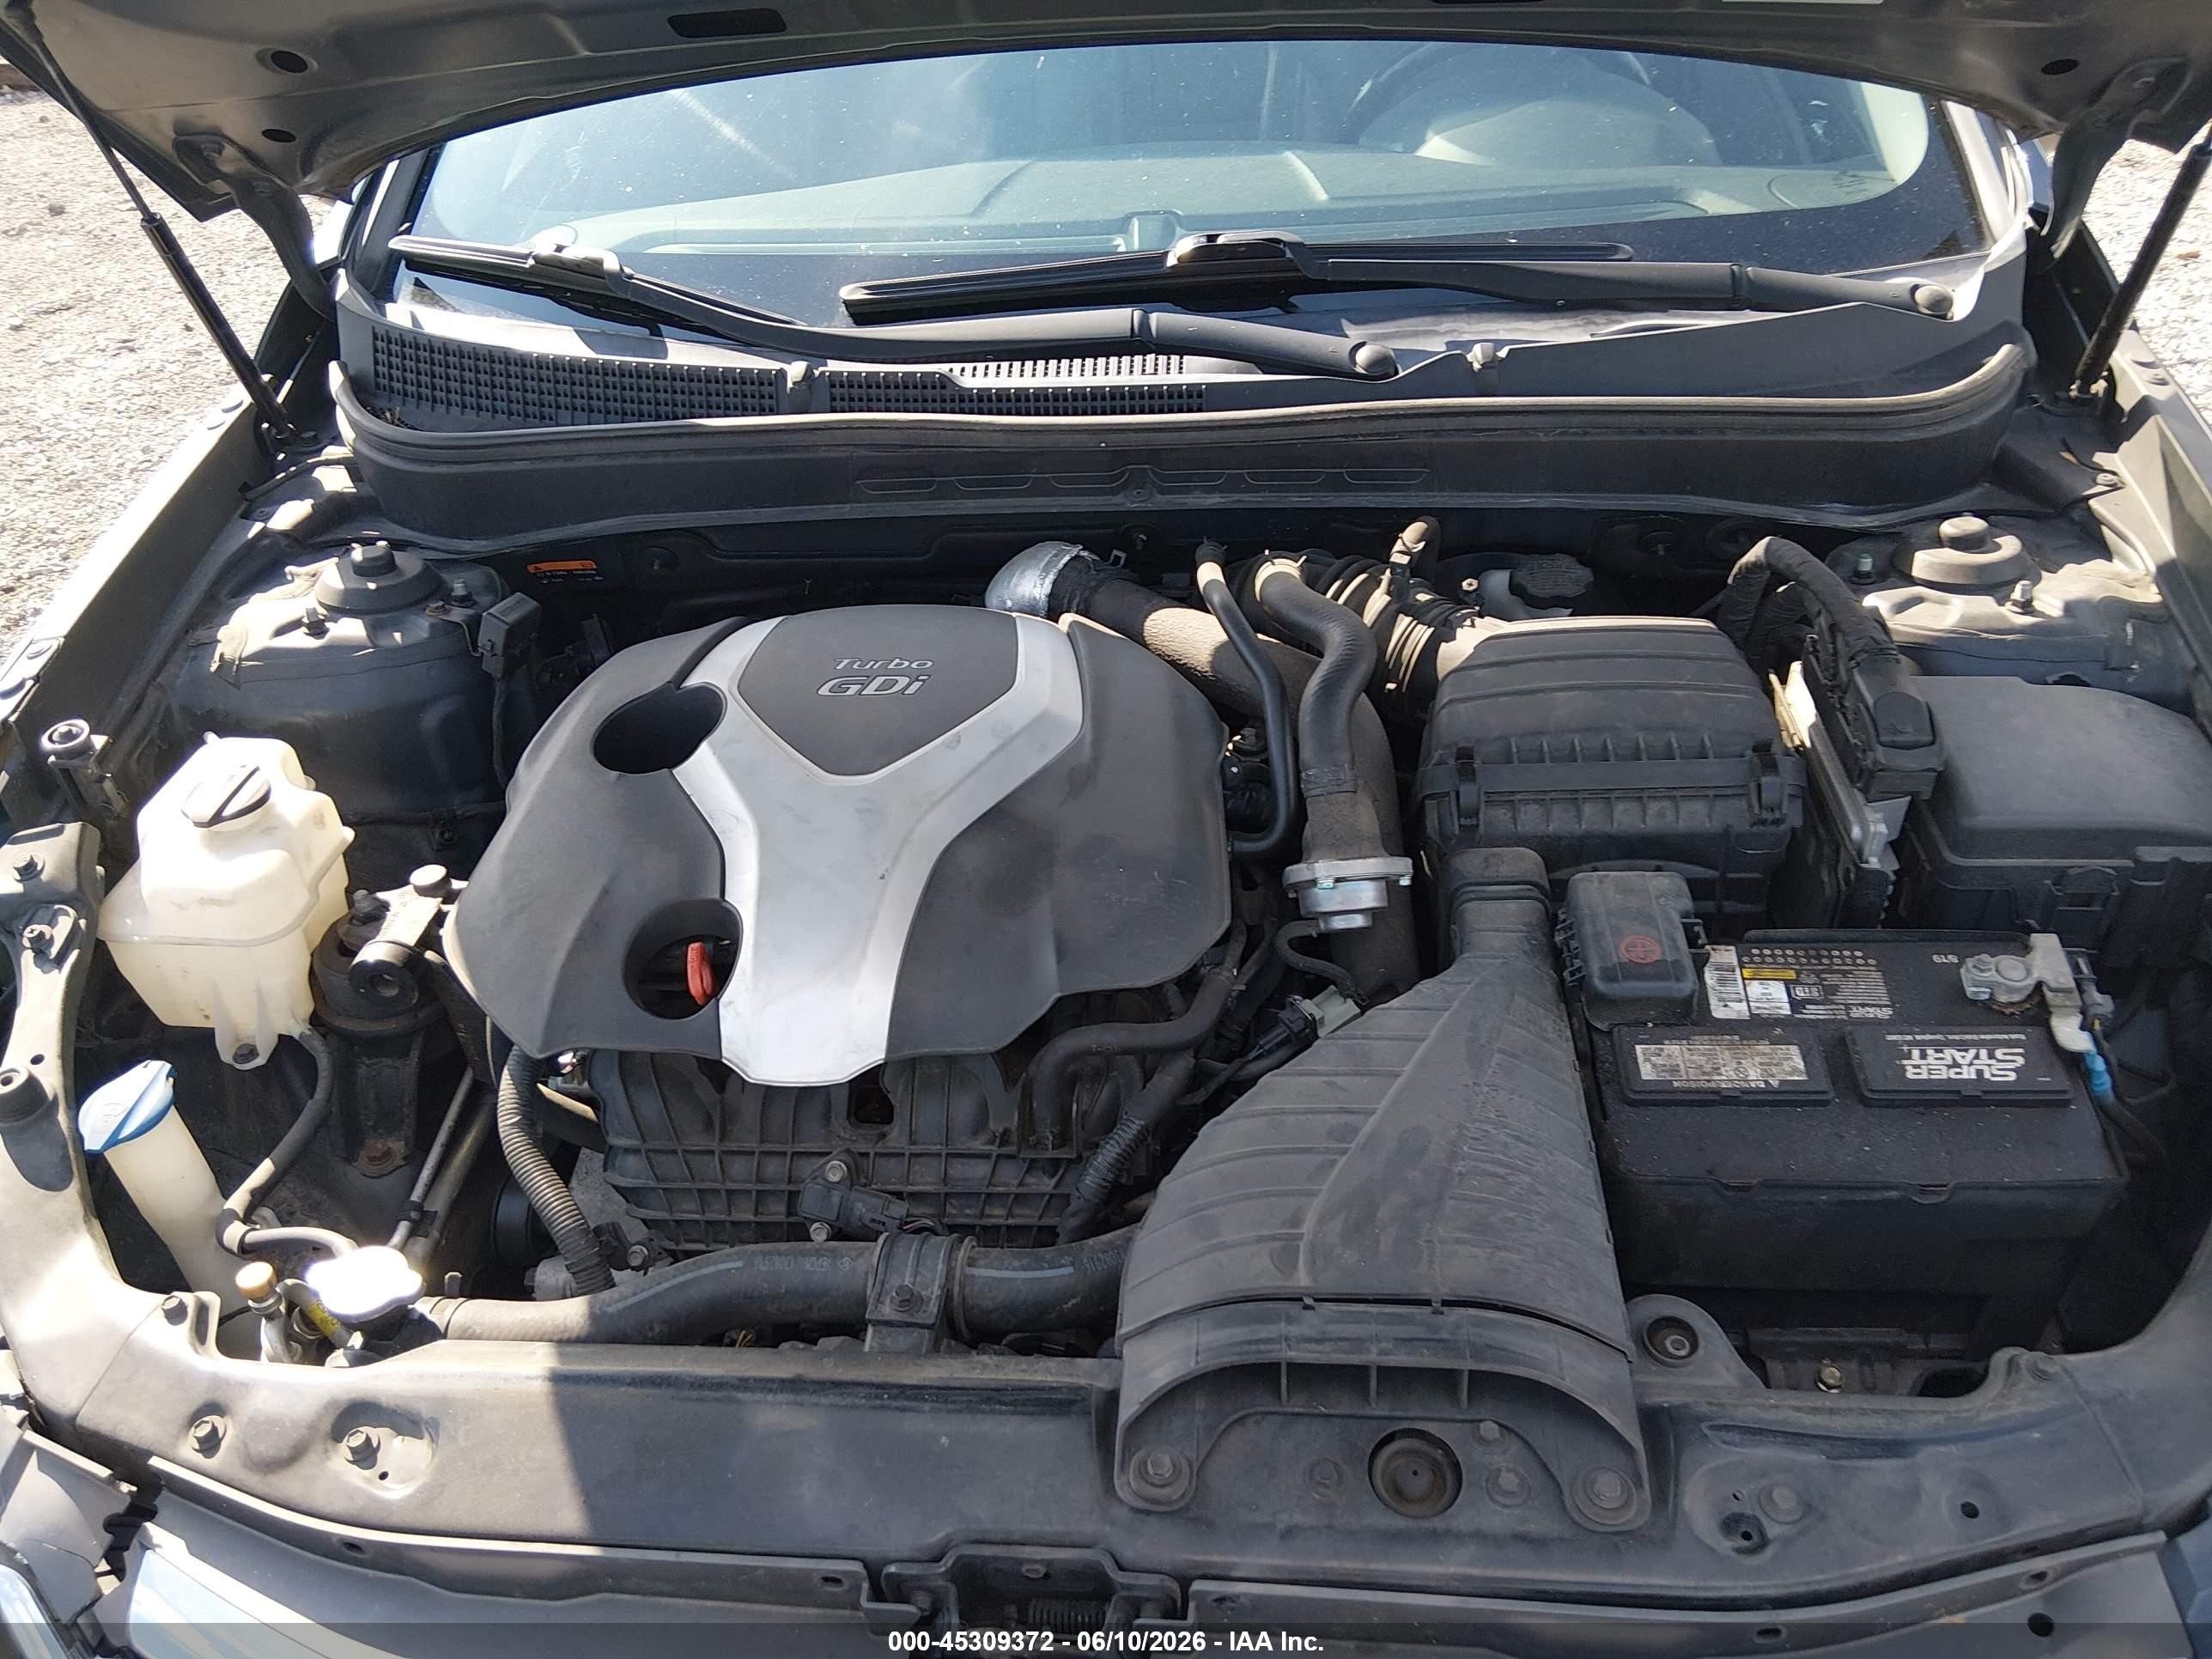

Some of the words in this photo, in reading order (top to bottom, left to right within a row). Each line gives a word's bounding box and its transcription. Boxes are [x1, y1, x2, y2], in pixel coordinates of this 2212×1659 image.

[834, 657, 934, 670] Turbo
[817, 674, 931, 696] GDi
[1899, 1048, 2026, 1066] START
[1905, 1065, 2018, 1081] SUPER
